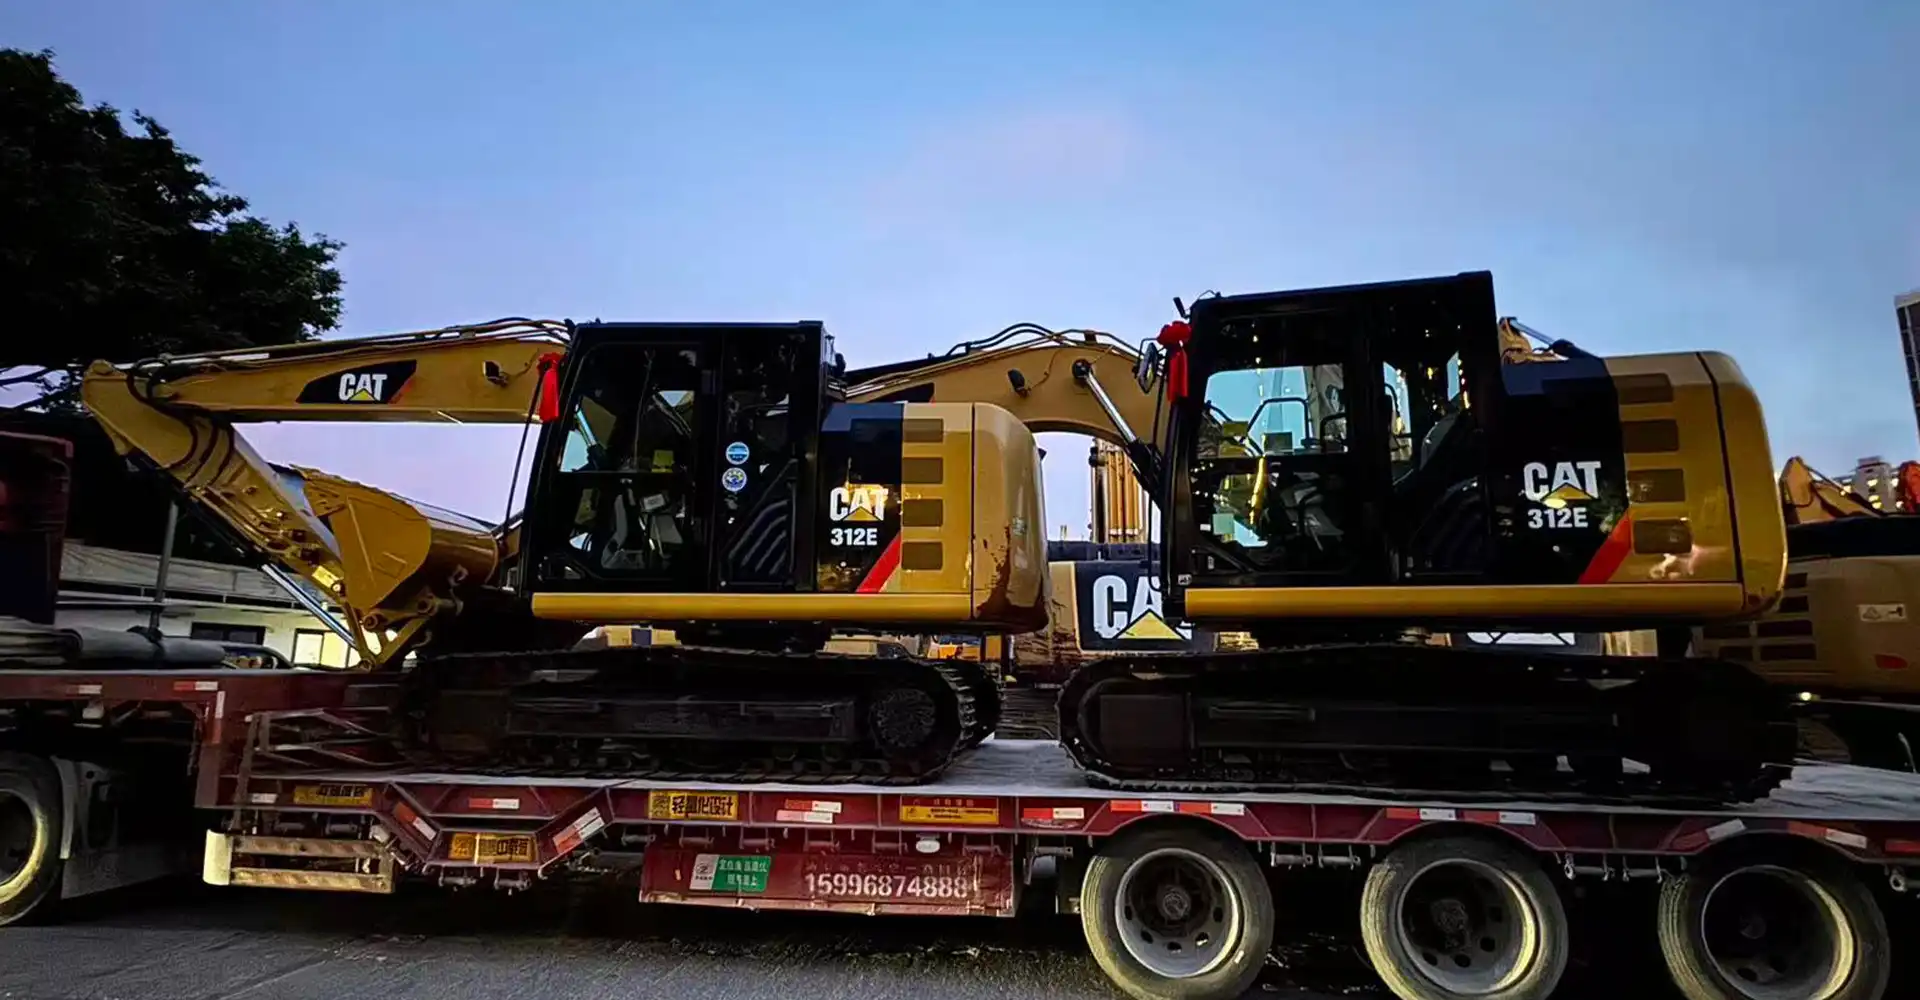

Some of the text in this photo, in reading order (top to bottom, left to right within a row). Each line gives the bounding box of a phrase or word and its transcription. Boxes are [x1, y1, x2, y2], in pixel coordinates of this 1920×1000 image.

[339, 373, 388, 401] CAT
[1523, 461, 1601, 502] CAT
[829, 486, 889, 521] CAT
[1527, 507, 1589, 529] 312E
[830, 527, 878, 546] 312E
[1093, 575, 1193, 640] CA
[805, 872, 968, 898] 15996874888
